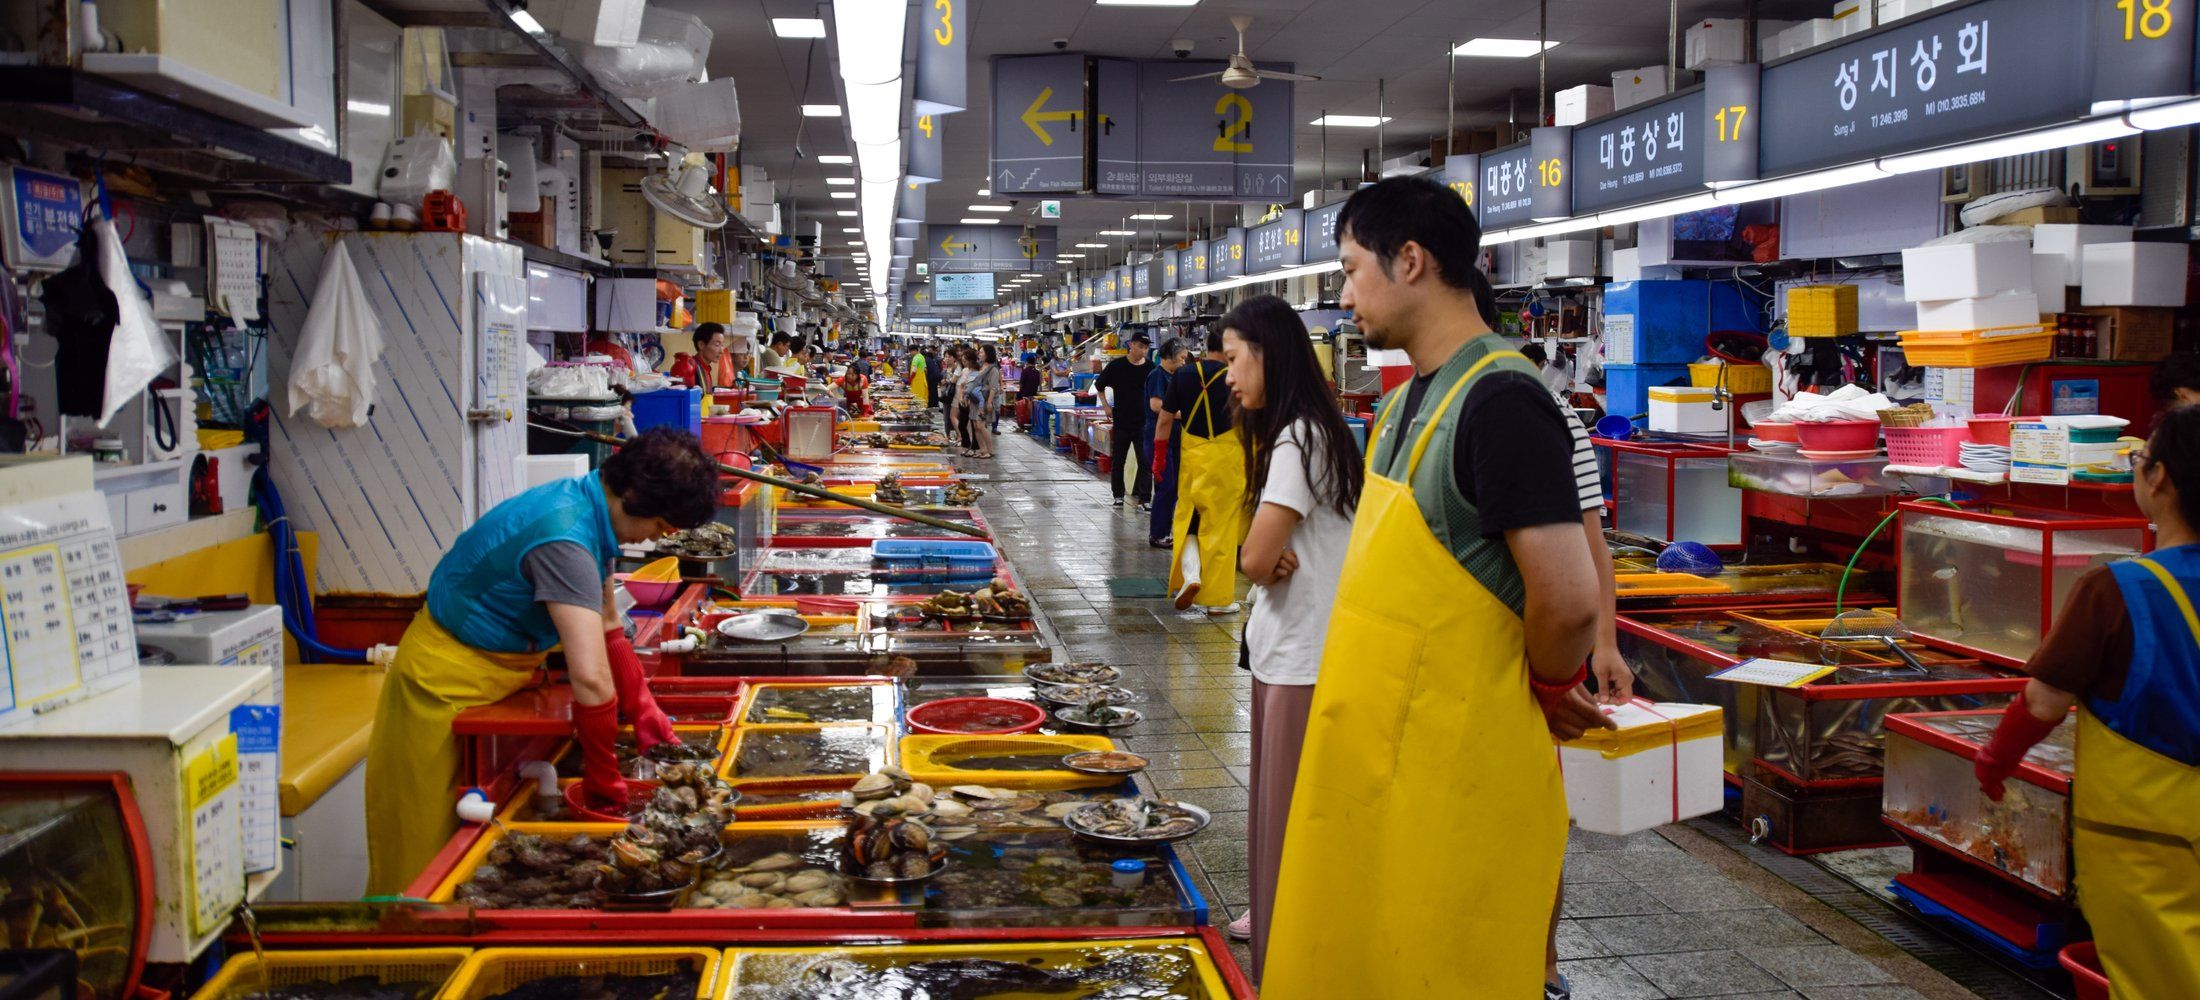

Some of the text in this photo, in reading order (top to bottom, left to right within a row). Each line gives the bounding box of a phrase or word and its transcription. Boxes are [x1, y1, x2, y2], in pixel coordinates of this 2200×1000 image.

[934, 0, 953, 46] 3
[2116, 0, 2172, 42] 18
[1835, 20, 1988, 111] 성지상회
[918, 116, 933, 139] 4
[1213, 93, 1254, 153] 2
[1714, 105, 1747, 142] 17
[1834, 124, 1848, 136] Sung
[1850, 121, 1855, 132] Ji
[1871, 114, 1878, 127] T)
[1926, 102, 1935, 115] M)
[1147, 172, 1192, 183] 외부화장실
[1487, 157, 1532, 196] 대흥상
[1538, 158, 1562, 187] 16
[1285, 230, 1298, 244] 14
[1195, 257, 1204, 269] 12
[1231, 245, 1242, 259] 13
[1122, 276, 1131, 288] 75
[1167, 264, 1175, 276] 11
